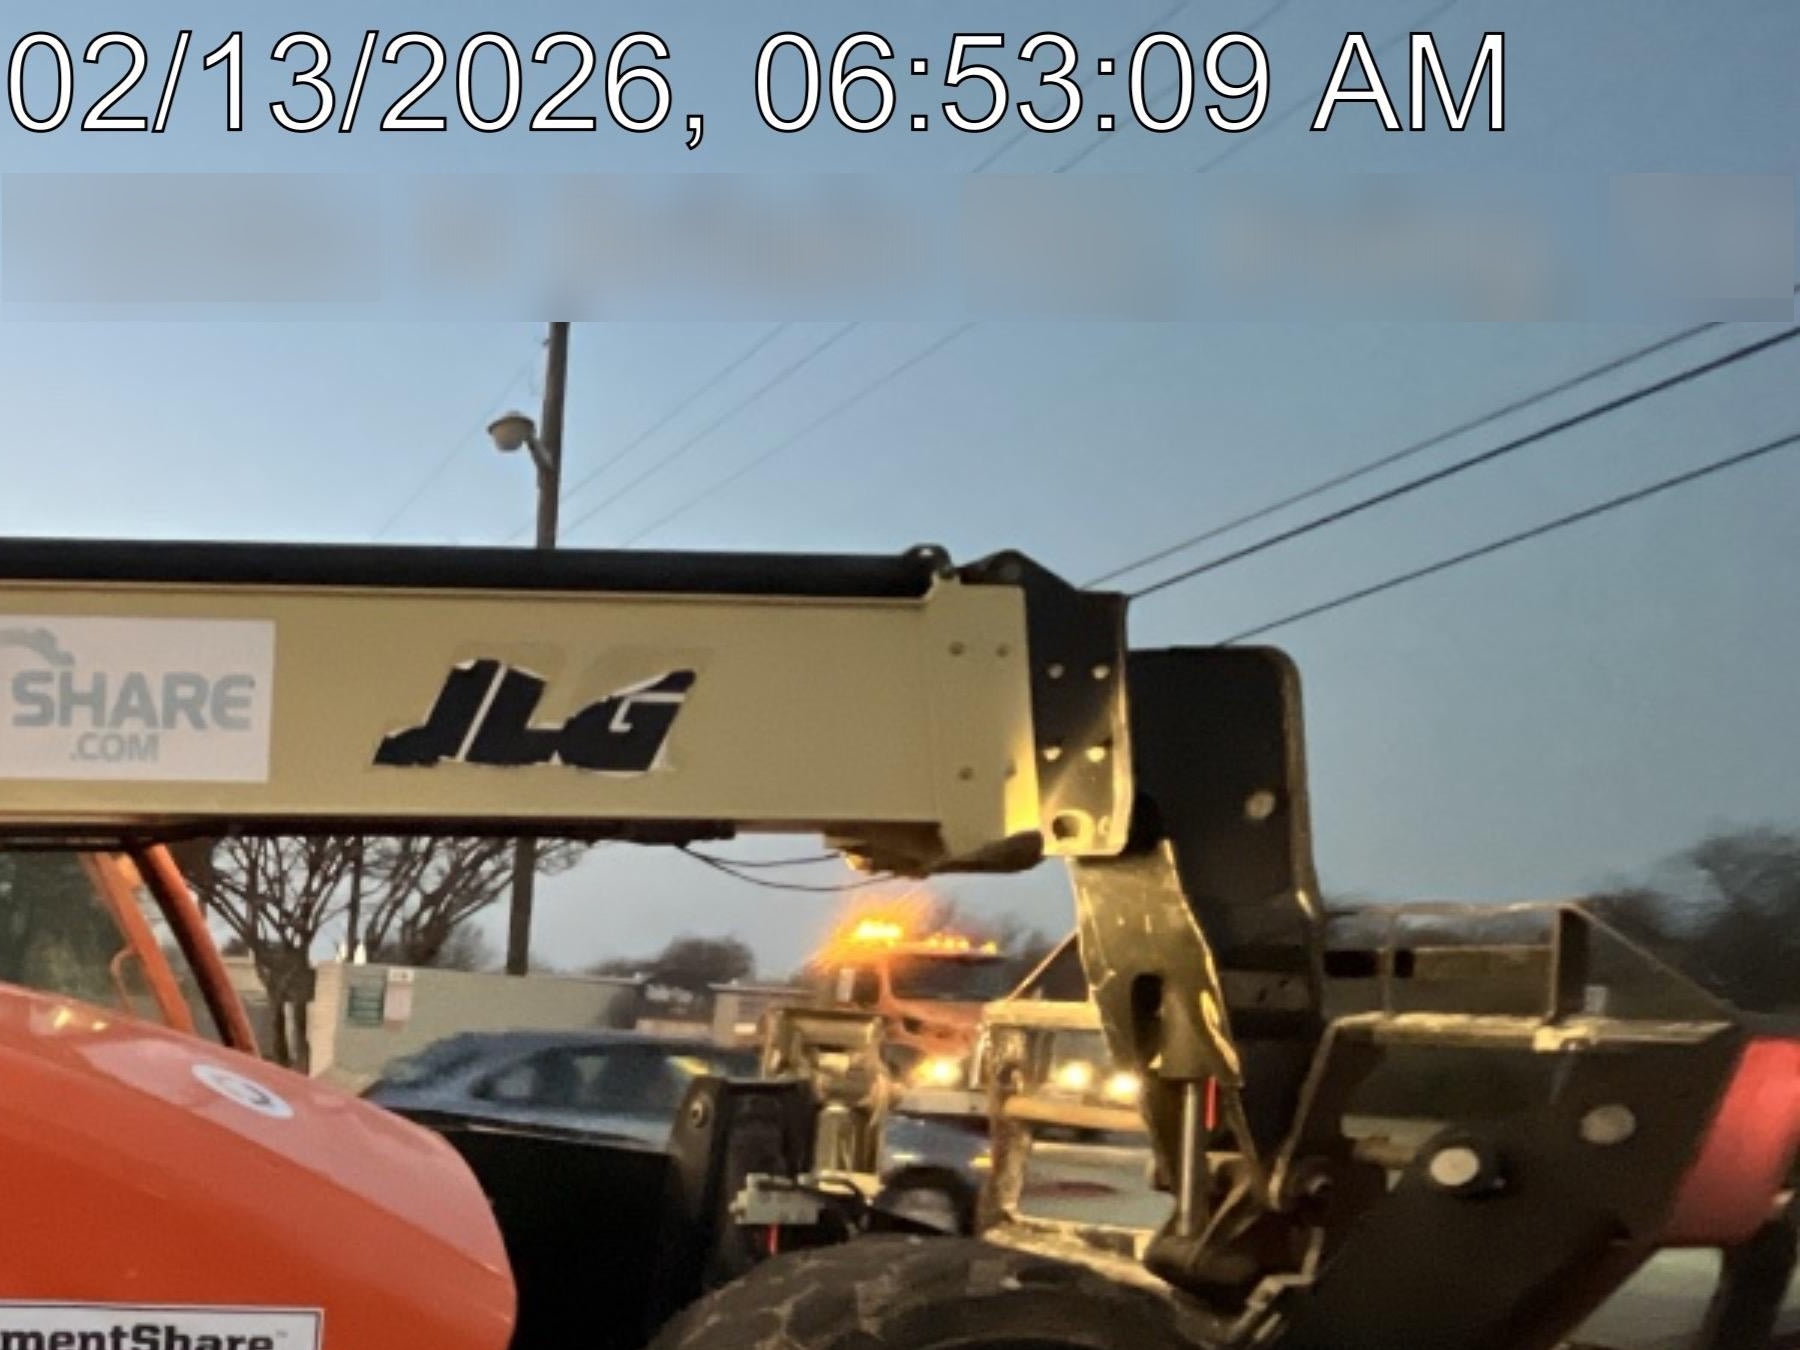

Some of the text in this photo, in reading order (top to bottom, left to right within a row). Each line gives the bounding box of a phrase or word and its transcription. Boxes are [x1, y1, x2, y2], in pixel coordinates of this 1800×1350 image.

[11, 670, 256, 731] SHARE
[373, 657, 697, 773] JLG
[70, 732, 160, 762] .COM
